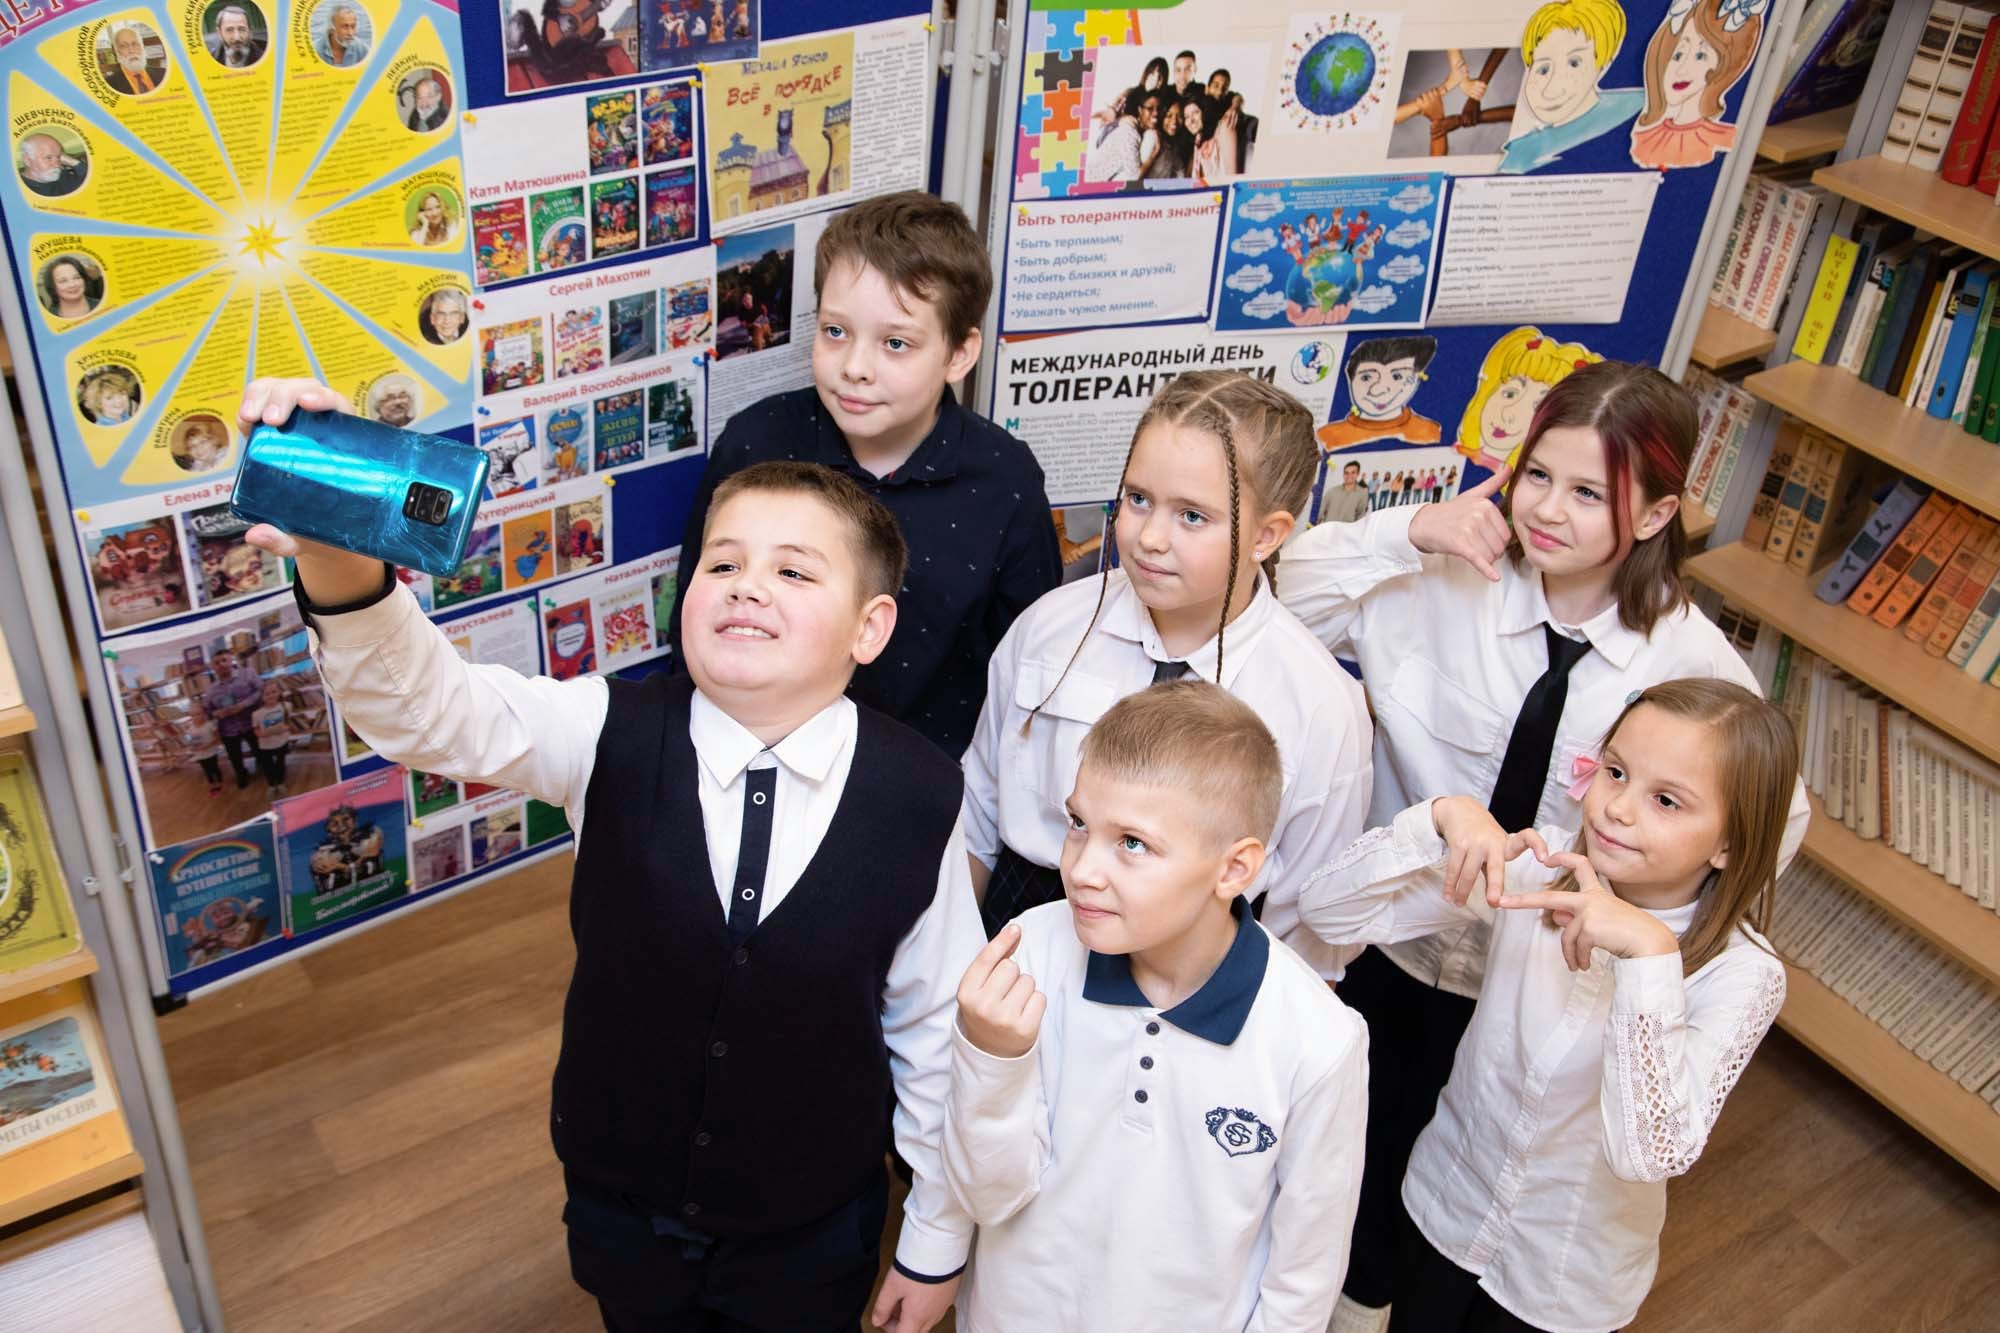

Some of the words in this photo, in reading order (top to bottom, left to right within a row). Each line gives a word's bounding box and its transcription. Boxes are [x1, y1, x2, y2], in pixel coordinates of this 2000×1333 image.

[15, 108, 75, 126] ШЕВЧЕНКО
[469, 182, 502, 200] Катя
[504, 168, 588, 194] Матюшкина
[1060, 208, 1163, 226] толерантным
[1167, 204, 1221, 219] значит:
[1020, 237, 1051, 250] Быть
[1054, 233, 1124, 249] терпимым;
[1019, 255, 1050, 267] Быть
[1052, 252, 1108, 267] добрым;
[549, 278, 594, 298] Сергей
[596, 266, 651, 291] Махотин
[1016, 272, 1066, 286] Любить
[1068, 268, 1117, 282] близких
[1120, 269, 1129, 278] и
[1130, 263, 1177, 279] друзей;
[1016, 290, 1033, 301] Не
[1035, 286, 1102, 302] сердиться;
[1014, 304, 1067, 320] Уважать
[1068, 302, 1107, 316] чужое
[1108, 299, 1159, 314] мнение.
[1010, 344, 1206, 376] МЕЖДУНАРОДНЫЙ
[1211, 344, 1265, 364] ДЕНЬ
[523, 385, 578, 409] Валерий
[581, 363, 673, 397] Воскобойников
[163, 488, 211, 506] Елена
[604, 565, 650, 585] Наталья
